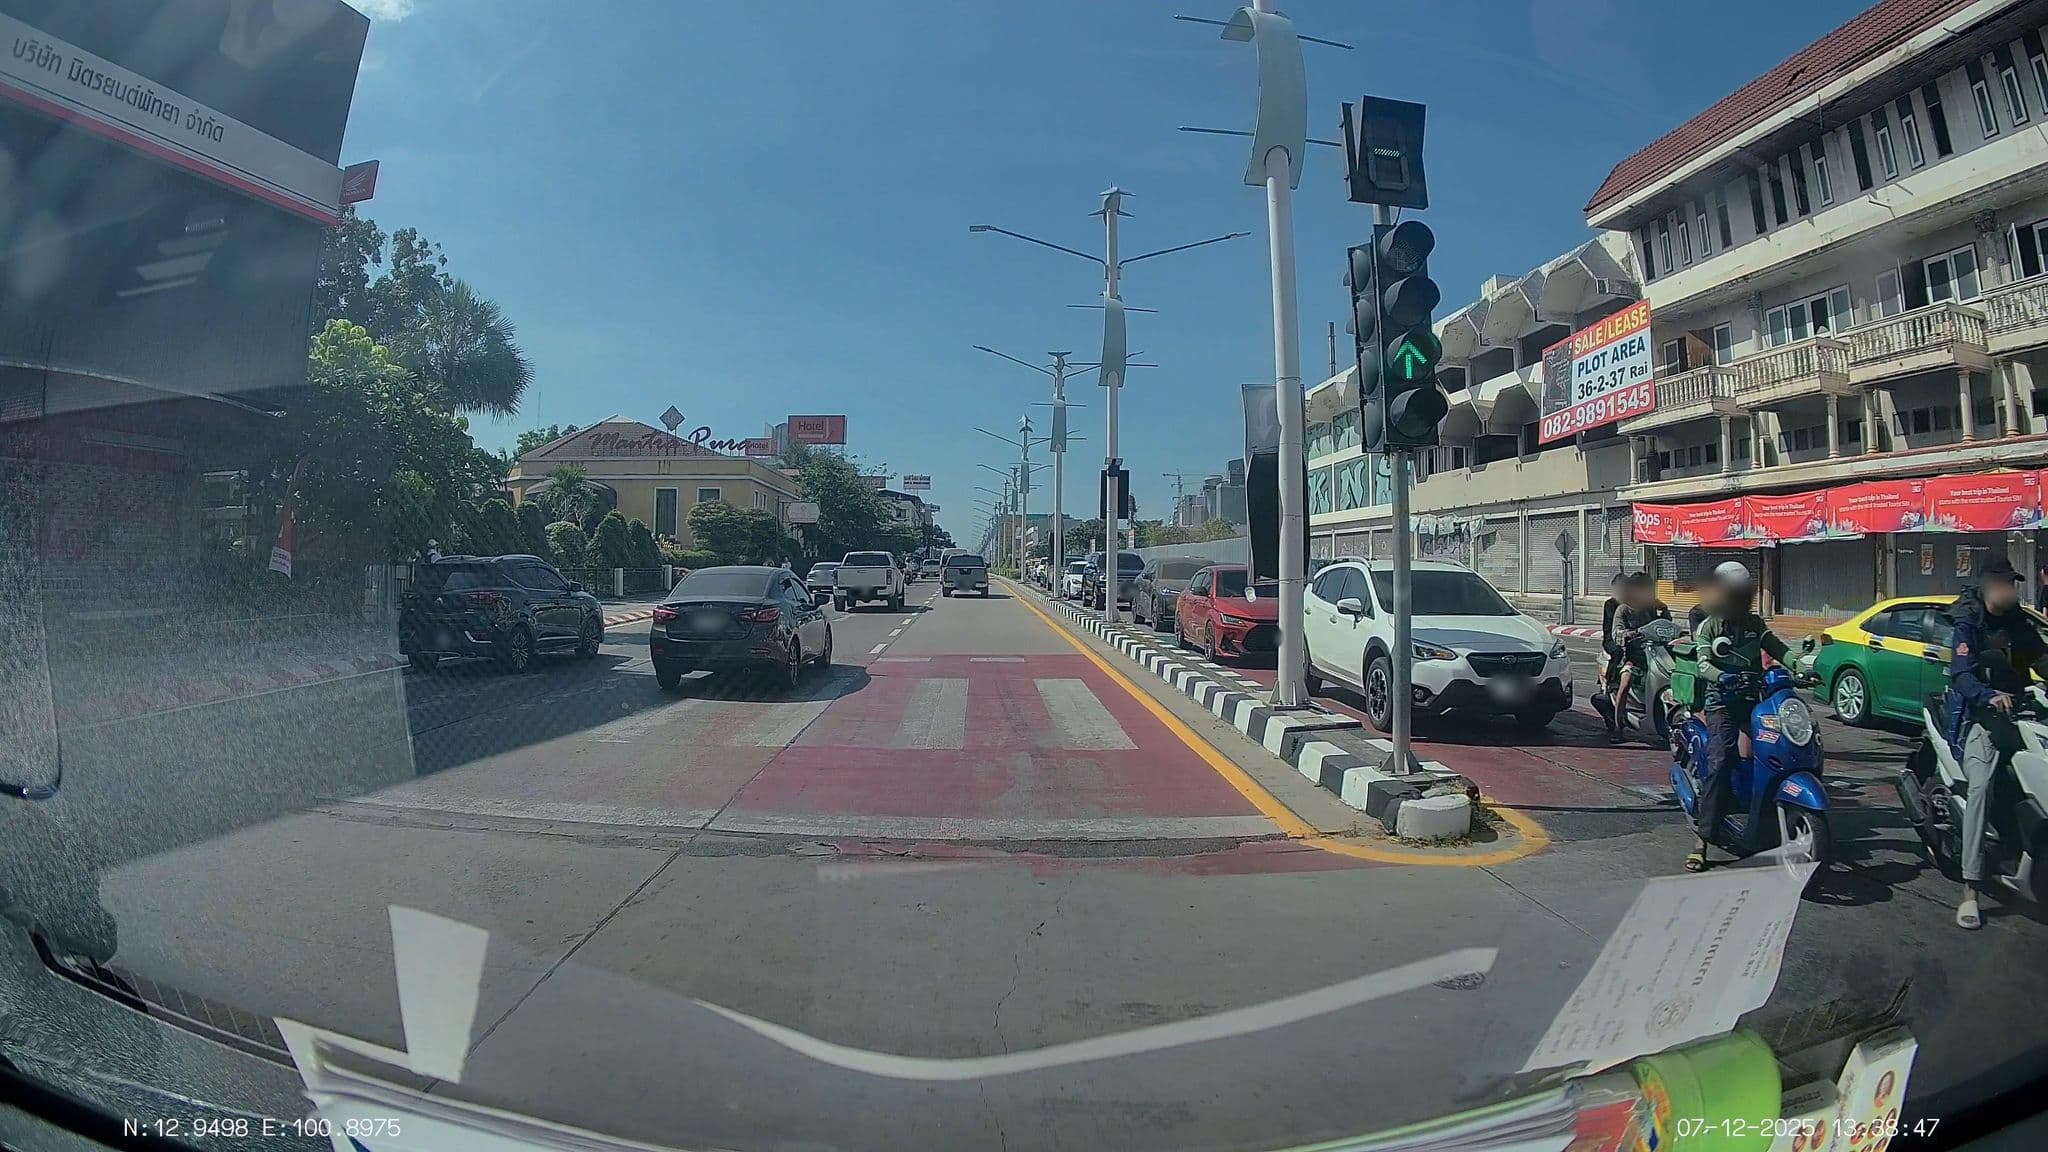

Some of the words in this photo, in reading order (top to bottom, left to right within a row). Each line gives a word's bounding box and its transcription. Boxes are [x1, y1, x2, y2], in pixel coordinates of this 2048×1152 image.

[13, 37, 62, 74] บริษัท
[67, 57, 180, 125] มิตรยนต์พัทยา
[186, 108, 225, 143] จำกัด
[1574, 305, 1648, 355] SALE/LEASE
[1577, 350, 1608, 378] PLOT
[1611, 335, 1646, 364] AREA
[1577, 366, 1626, 400] 36-2-37
[1630, 361, 1648, 379] Rai
[798, 420, 824, 431] Hotel
[1543, 384, 1650, 439] 082-9891545
[1987, 486, 2009, 494] Thailand
[1634, 509, 1660, 529] Tops
